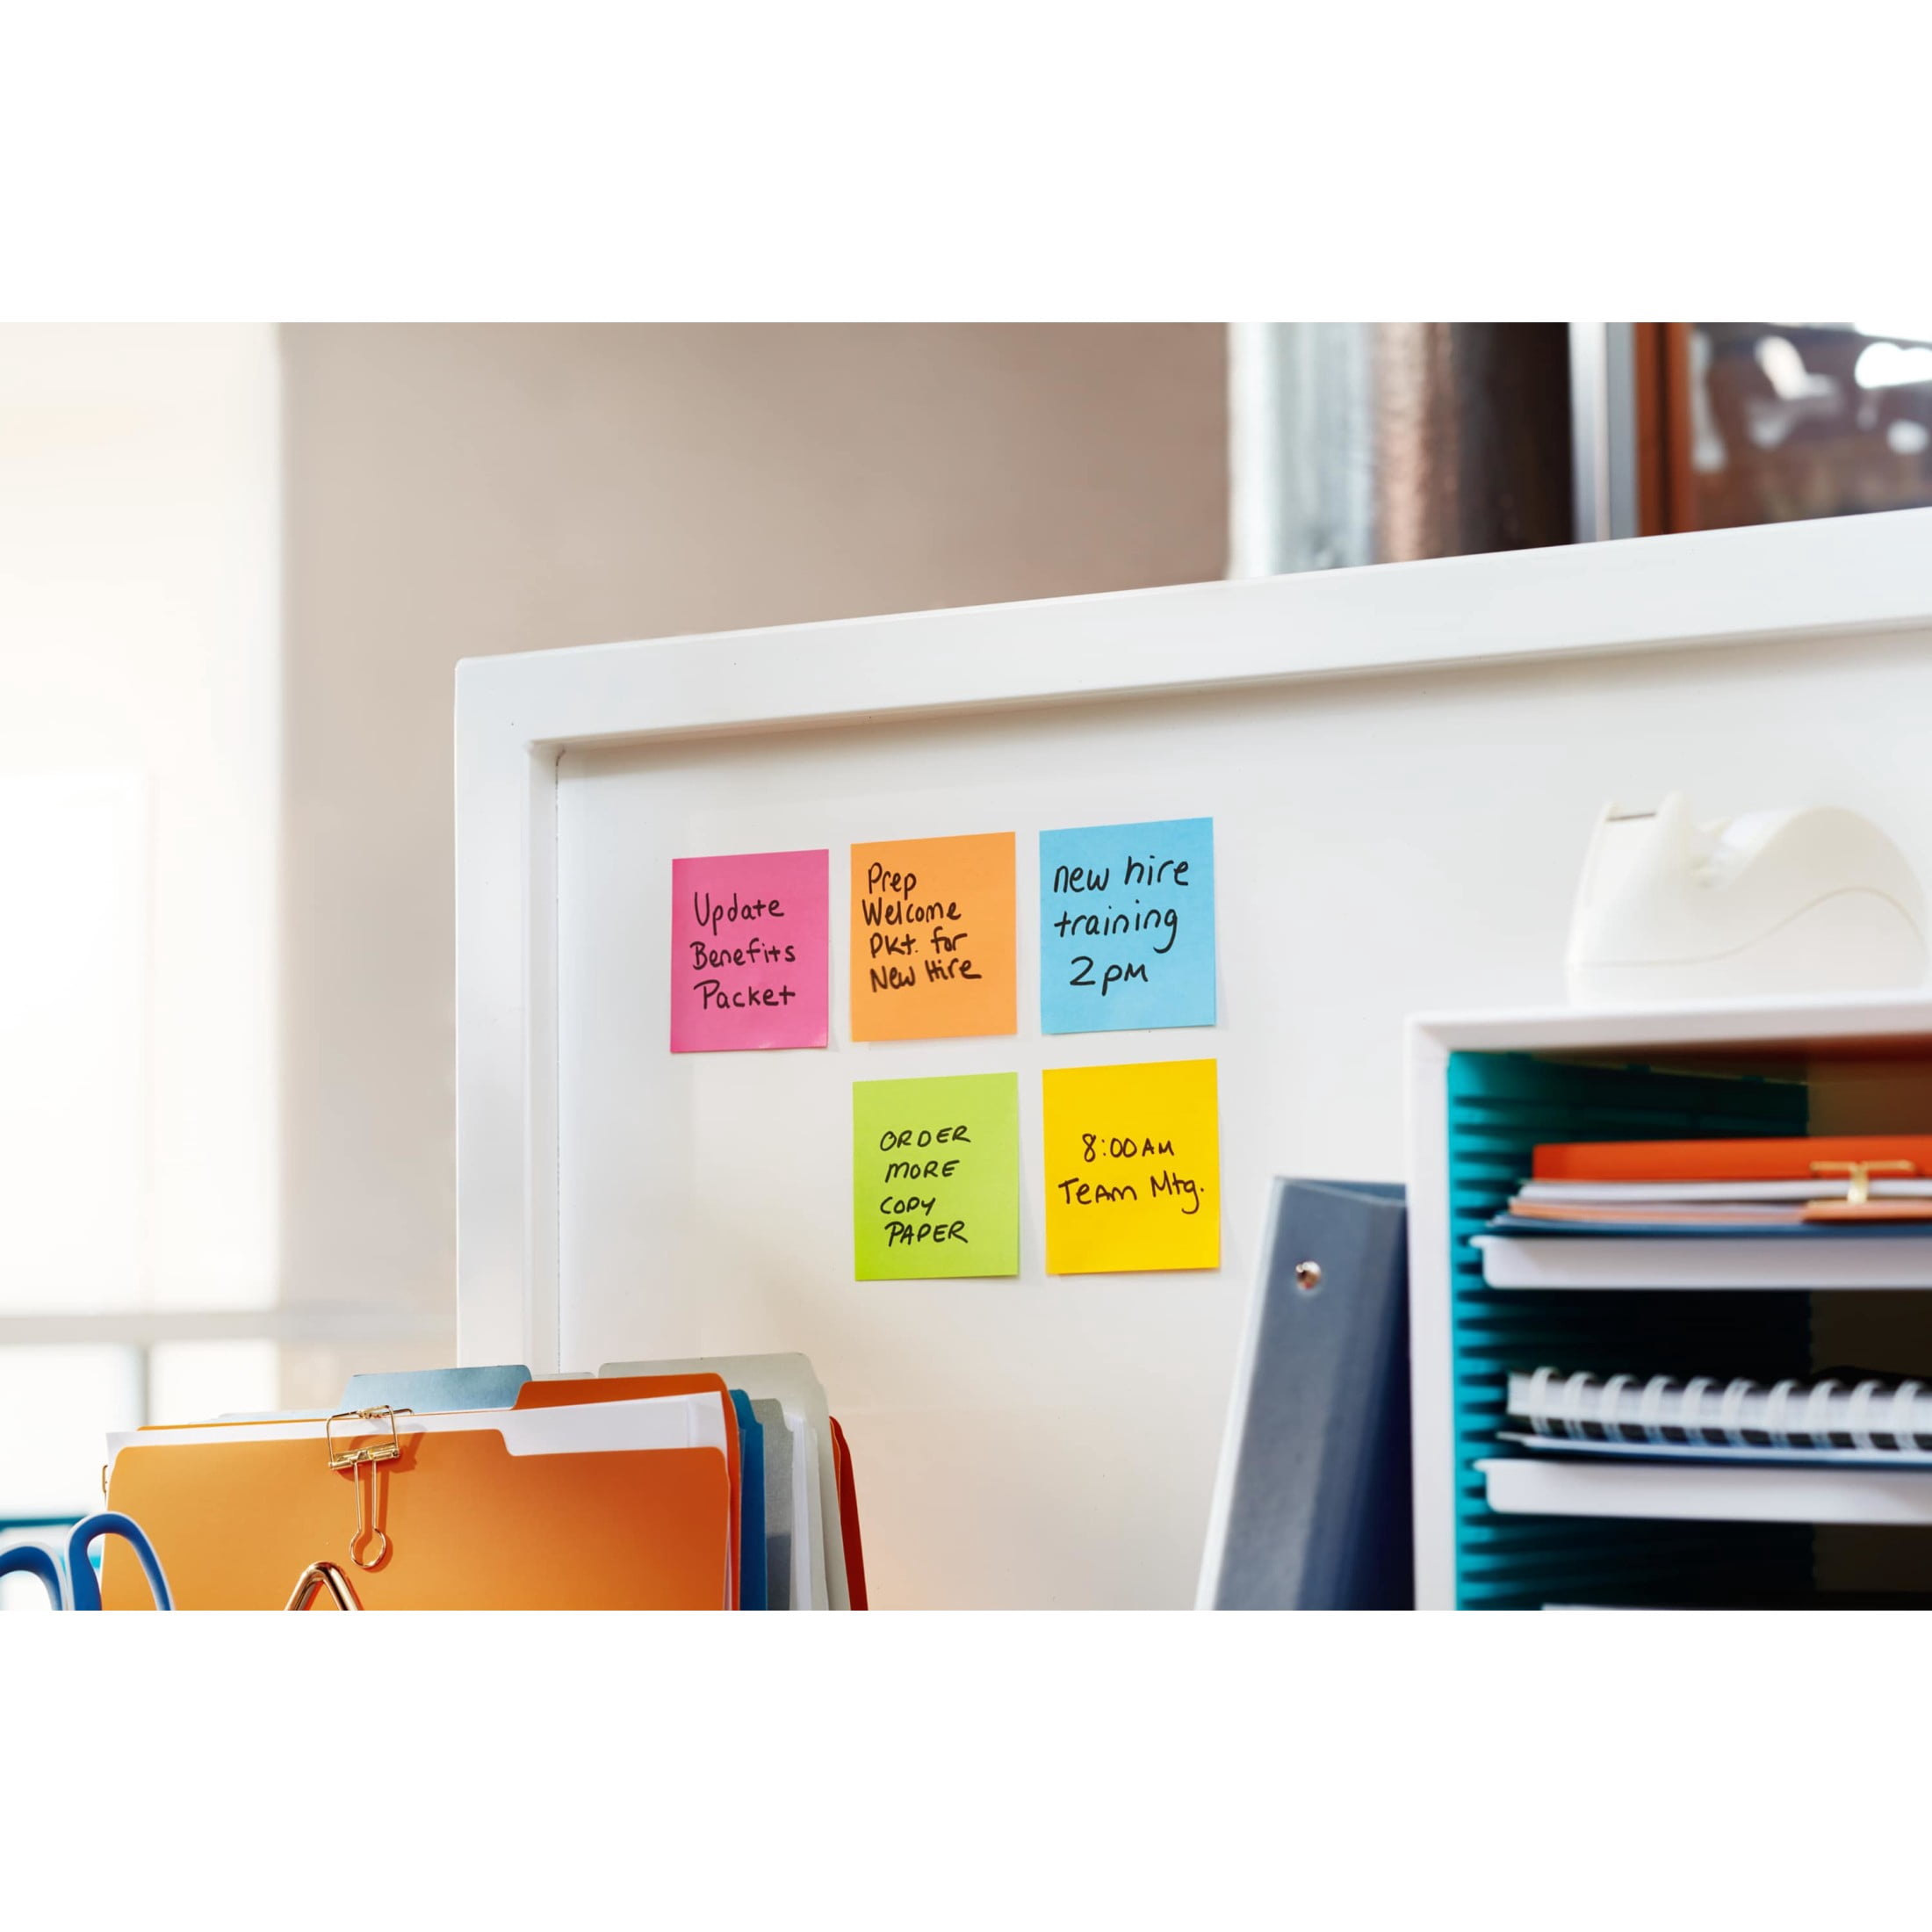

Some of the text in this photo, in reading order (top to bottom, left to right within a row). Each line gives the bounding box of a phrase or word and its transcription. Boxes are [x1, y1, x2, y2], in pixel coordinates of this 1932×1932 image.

[866, 861, 918, 901] Prep
[1051, 854, 1190, 894] new hire
[693, 891, 785, 937] Update
[861, 897, 962, 926] Welcome
[1053, 898, 1179, 955] training
[688, 937, 797, 971] Benefits
[930, 925, 969, 955] for
[869, 957, 983, 993] New Hire
[693, 978, 797, 1010] Packet
[878, 1124, 972, 1153] ORDER
[883, 1158, 961, 1184] MORE
[1150, 1170, 1206, 1215] Mtg.
[883, 1220, 970, 1248] PAPER
